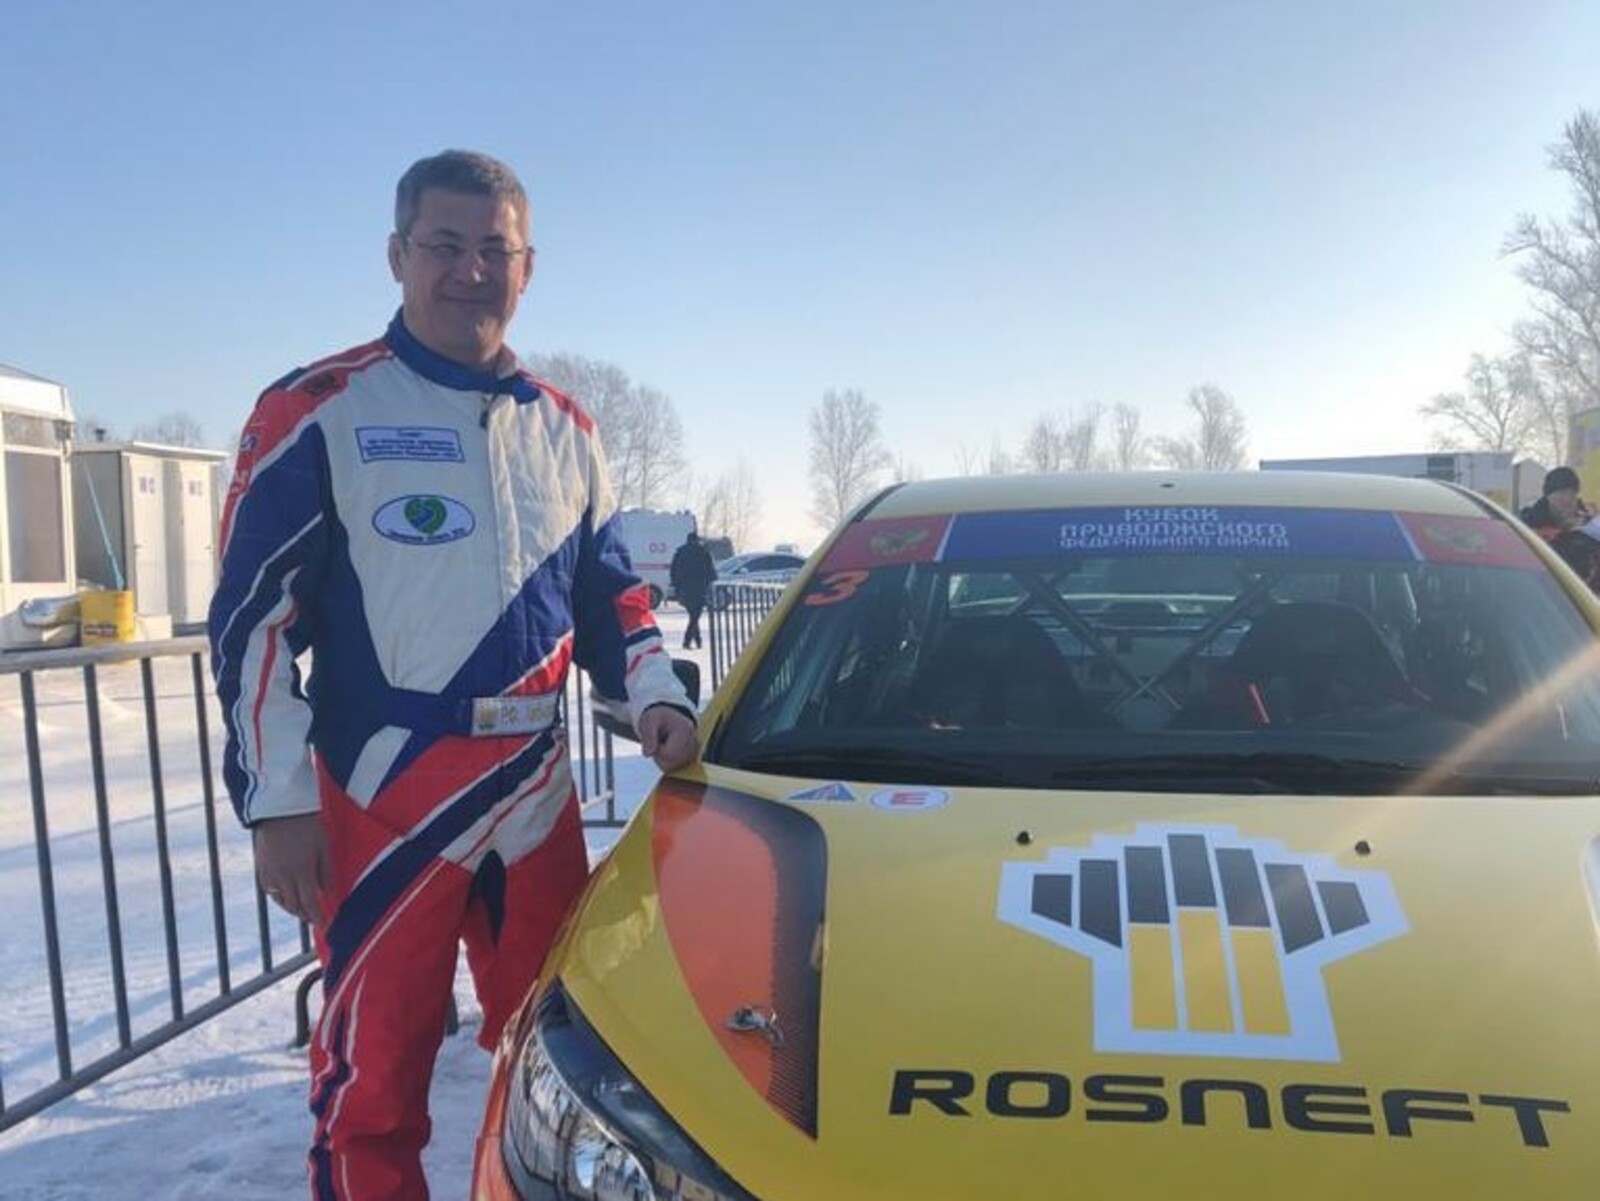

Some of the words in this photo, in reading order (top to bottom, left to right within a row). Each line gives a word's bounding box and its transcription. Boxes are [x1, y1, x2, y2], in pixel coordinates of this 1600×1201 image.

[1124, 507, 1219, 522] КУБОК
[1060, 522, 1288, 538] ПРИВОЛЖСКОГО
[804, 569, 870, 606] 3
[888, 1069, 1572, 1149] ROSNEFT
